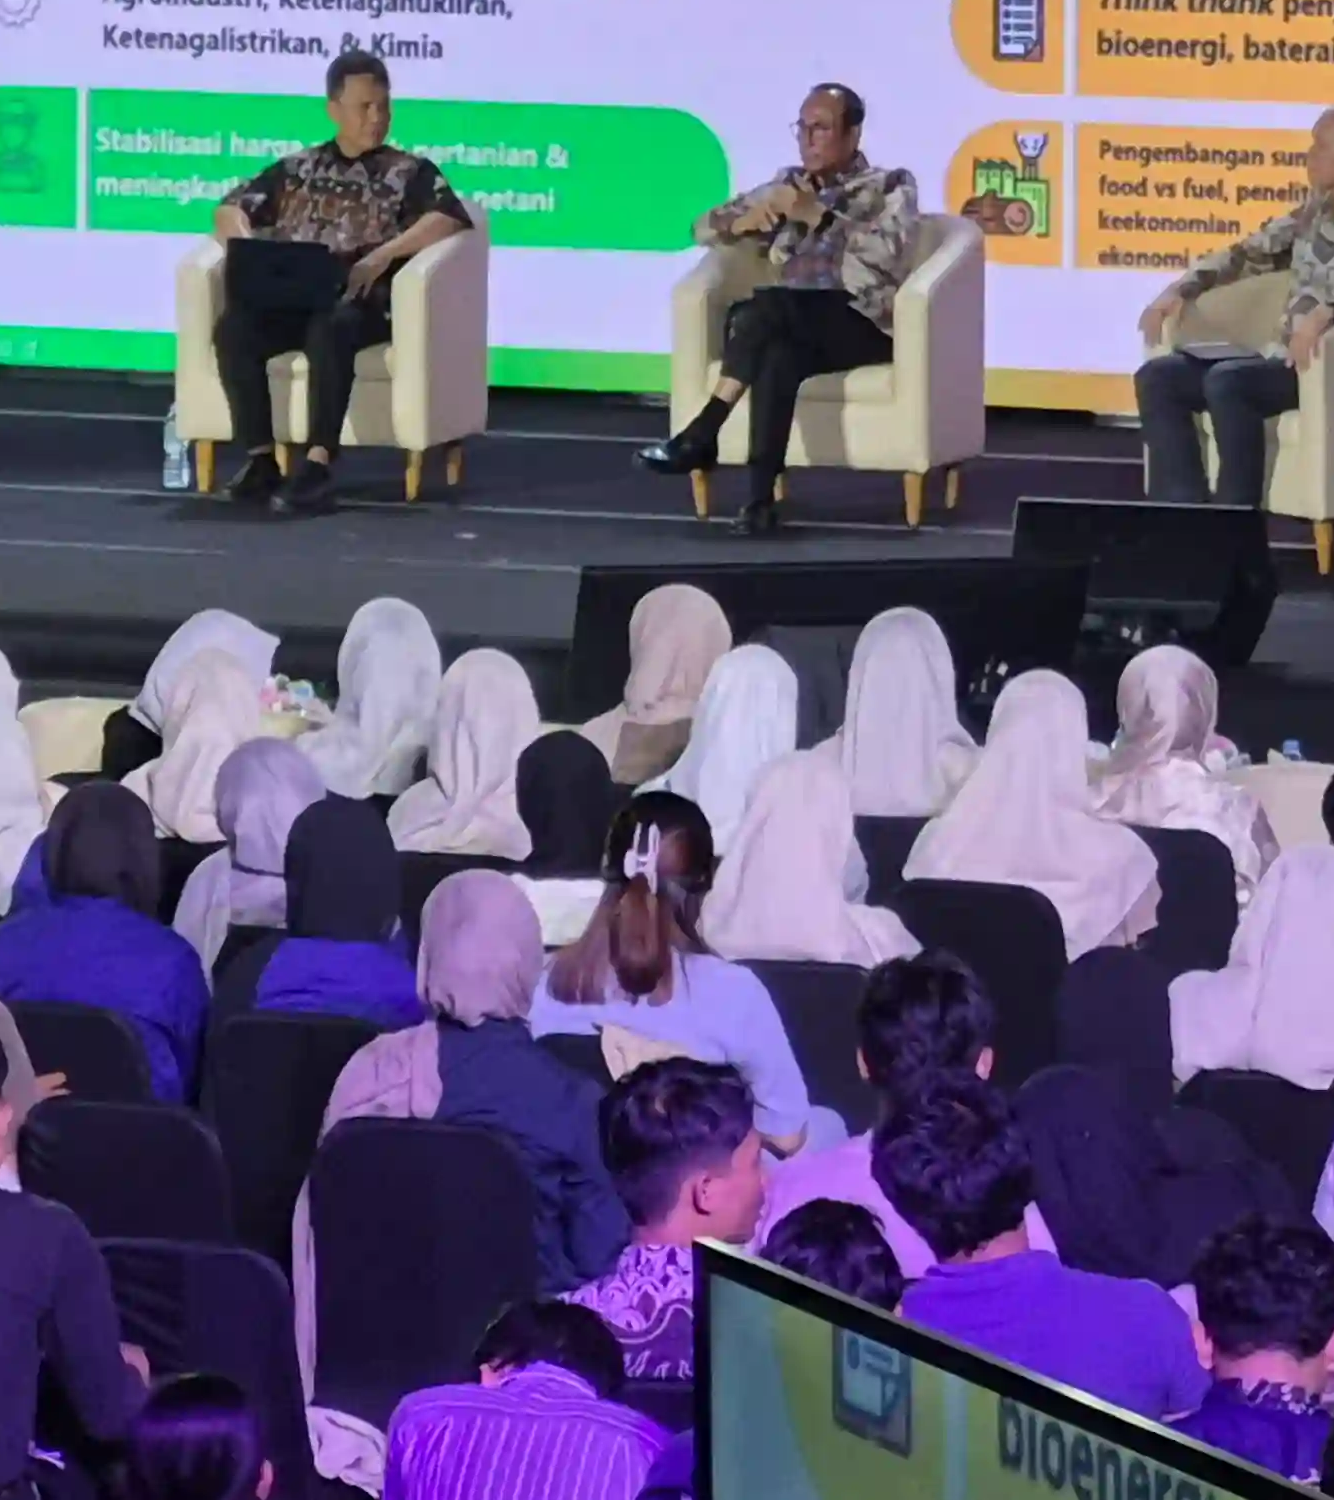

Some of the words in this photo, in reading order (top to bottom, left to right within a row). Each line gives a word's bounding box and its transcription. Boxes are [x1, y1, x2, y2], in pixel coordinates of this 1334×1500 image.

[103, 25, 329, 60] Ketenagalistrikan,
[371, 32, 443, 59] Kimia
[1097, 30, 1233, 66] bioenergi,
[95, 127, 221, 155] Stabilisasi
[1099, 140, 1264, 170] Pengembangan
[1099, 174, 1148, 197] food
[1154, 182, 1176, 197] vs
[1184, 178, 1228, 203] fuel,
